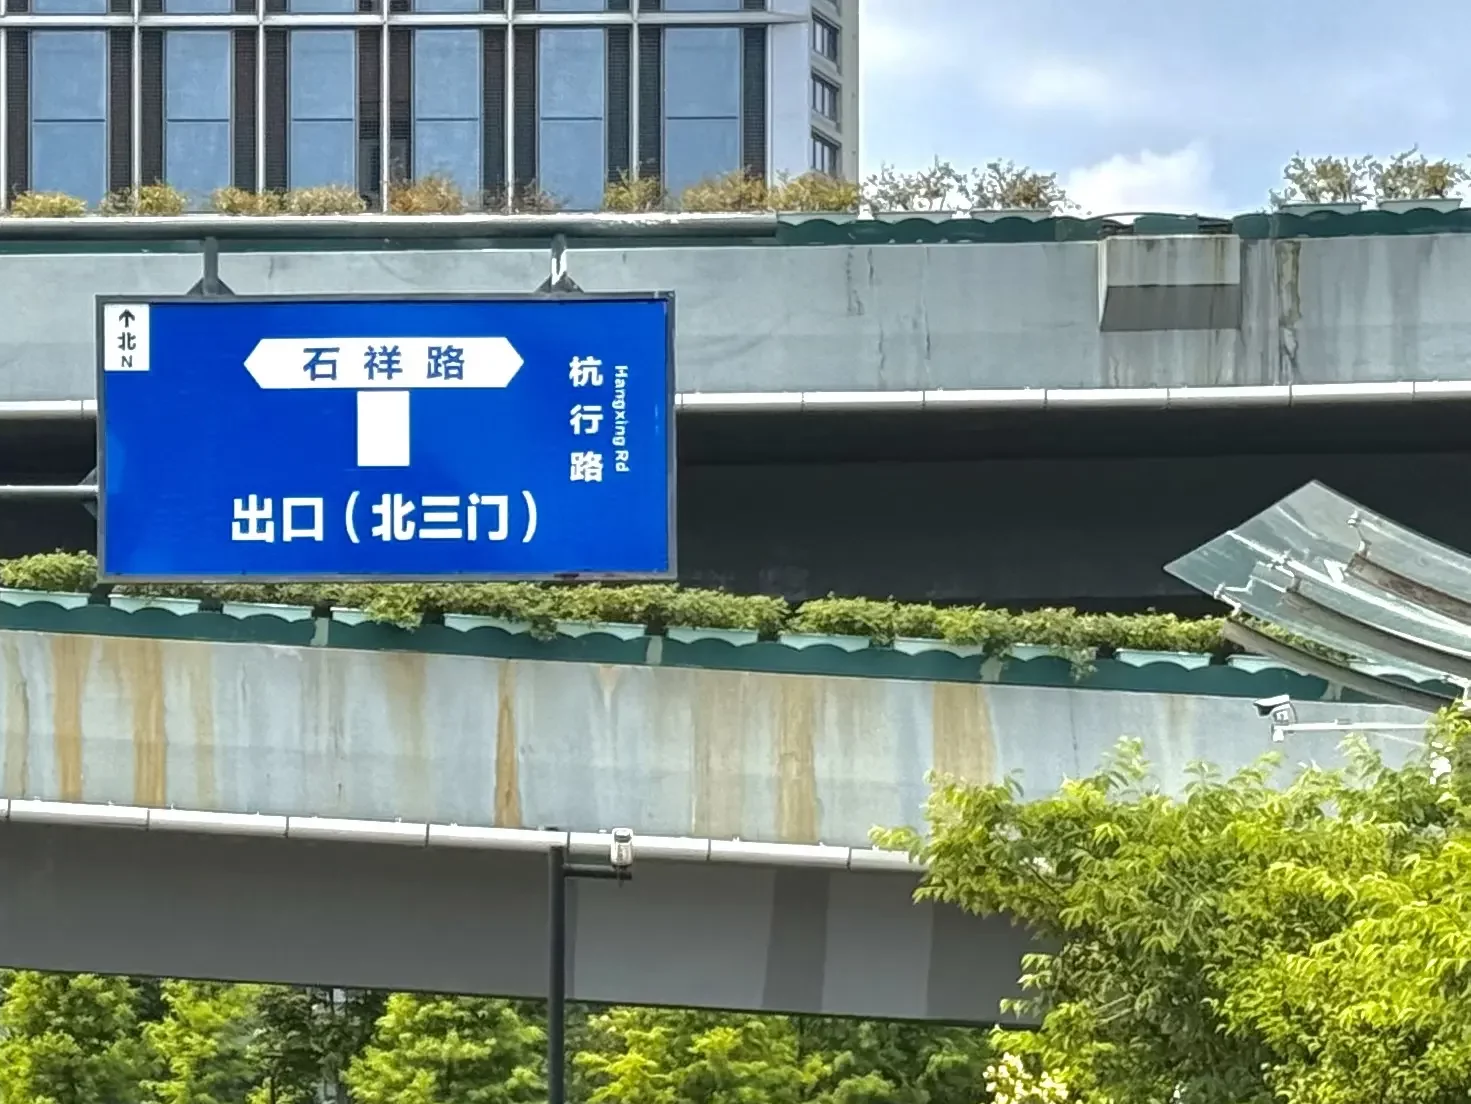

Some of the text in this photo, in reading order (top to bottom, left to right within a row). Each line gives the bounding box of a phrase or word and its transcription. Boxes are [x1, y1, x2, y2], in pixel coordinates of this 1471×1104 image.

[117, 332, 136, 351] 北
[121, 355, 133, 368] N
[302, 345, 465, 381] 石祥路
[569, 355, 604, 482] 杭行路
[611, 365, 630, 472] Hangxing Rd
